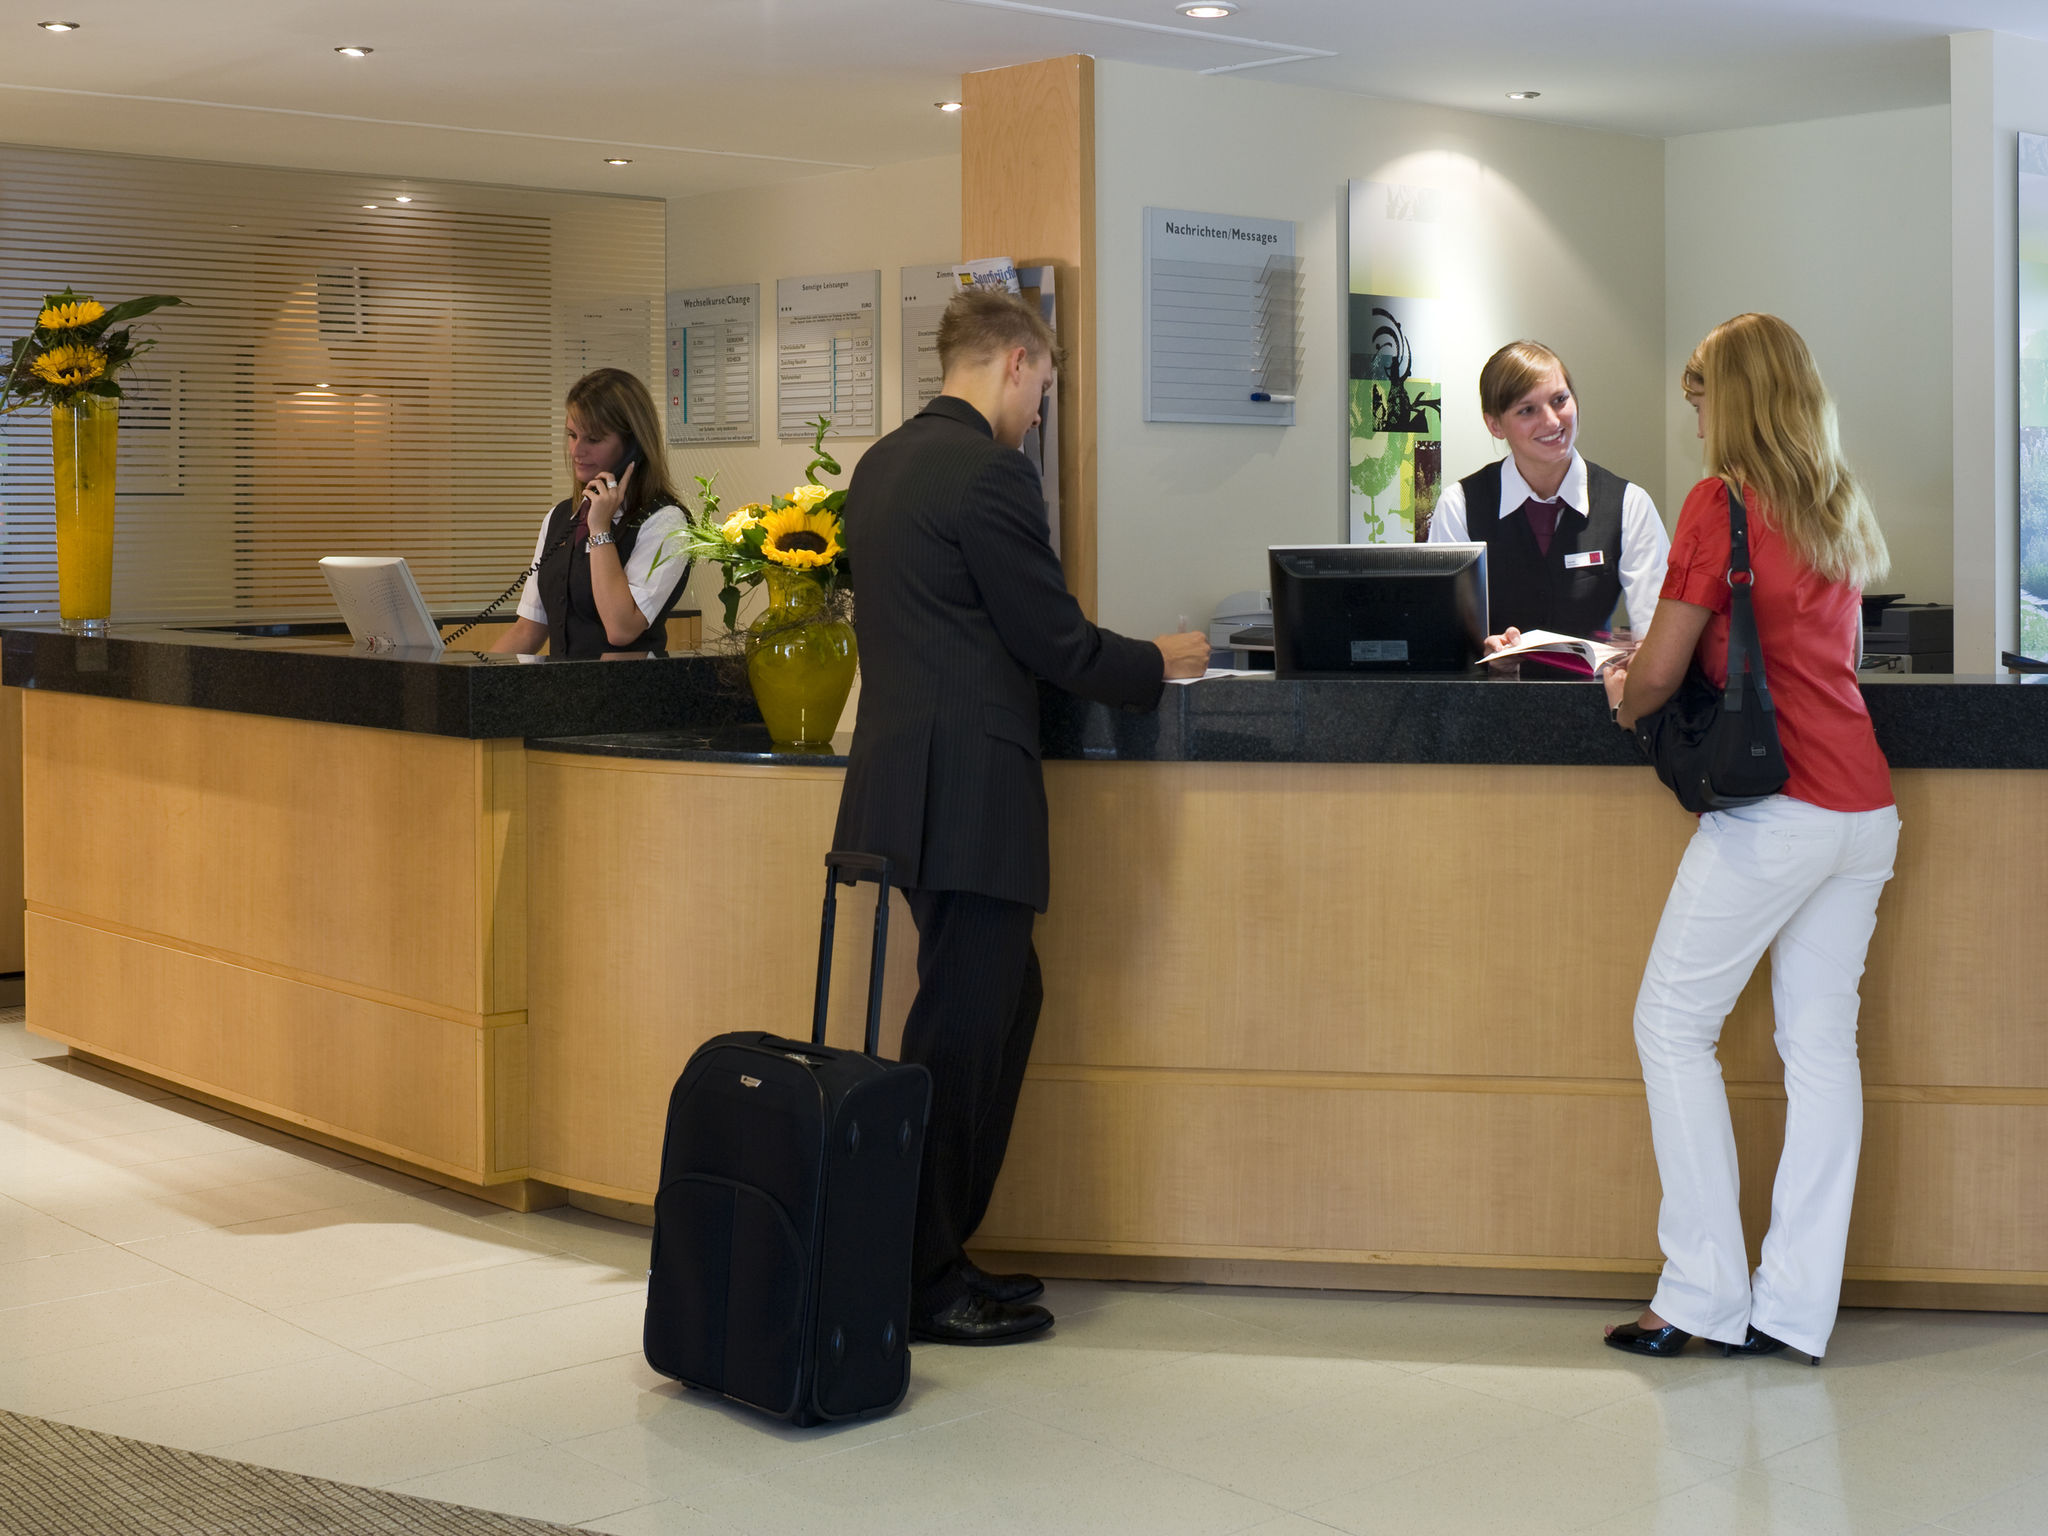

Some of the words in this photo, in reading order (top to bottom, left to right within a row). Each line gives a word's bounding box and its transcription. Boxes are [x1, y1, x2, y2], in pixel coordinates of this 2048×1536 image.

[1165, 221, 1278, 245] Nachrichten/Messages
[802, 283, 822, 291] Sonstige
[823, 281, 849, 289] Leistungen
[683, 295, 751, 309] Wechselkurse/Change
